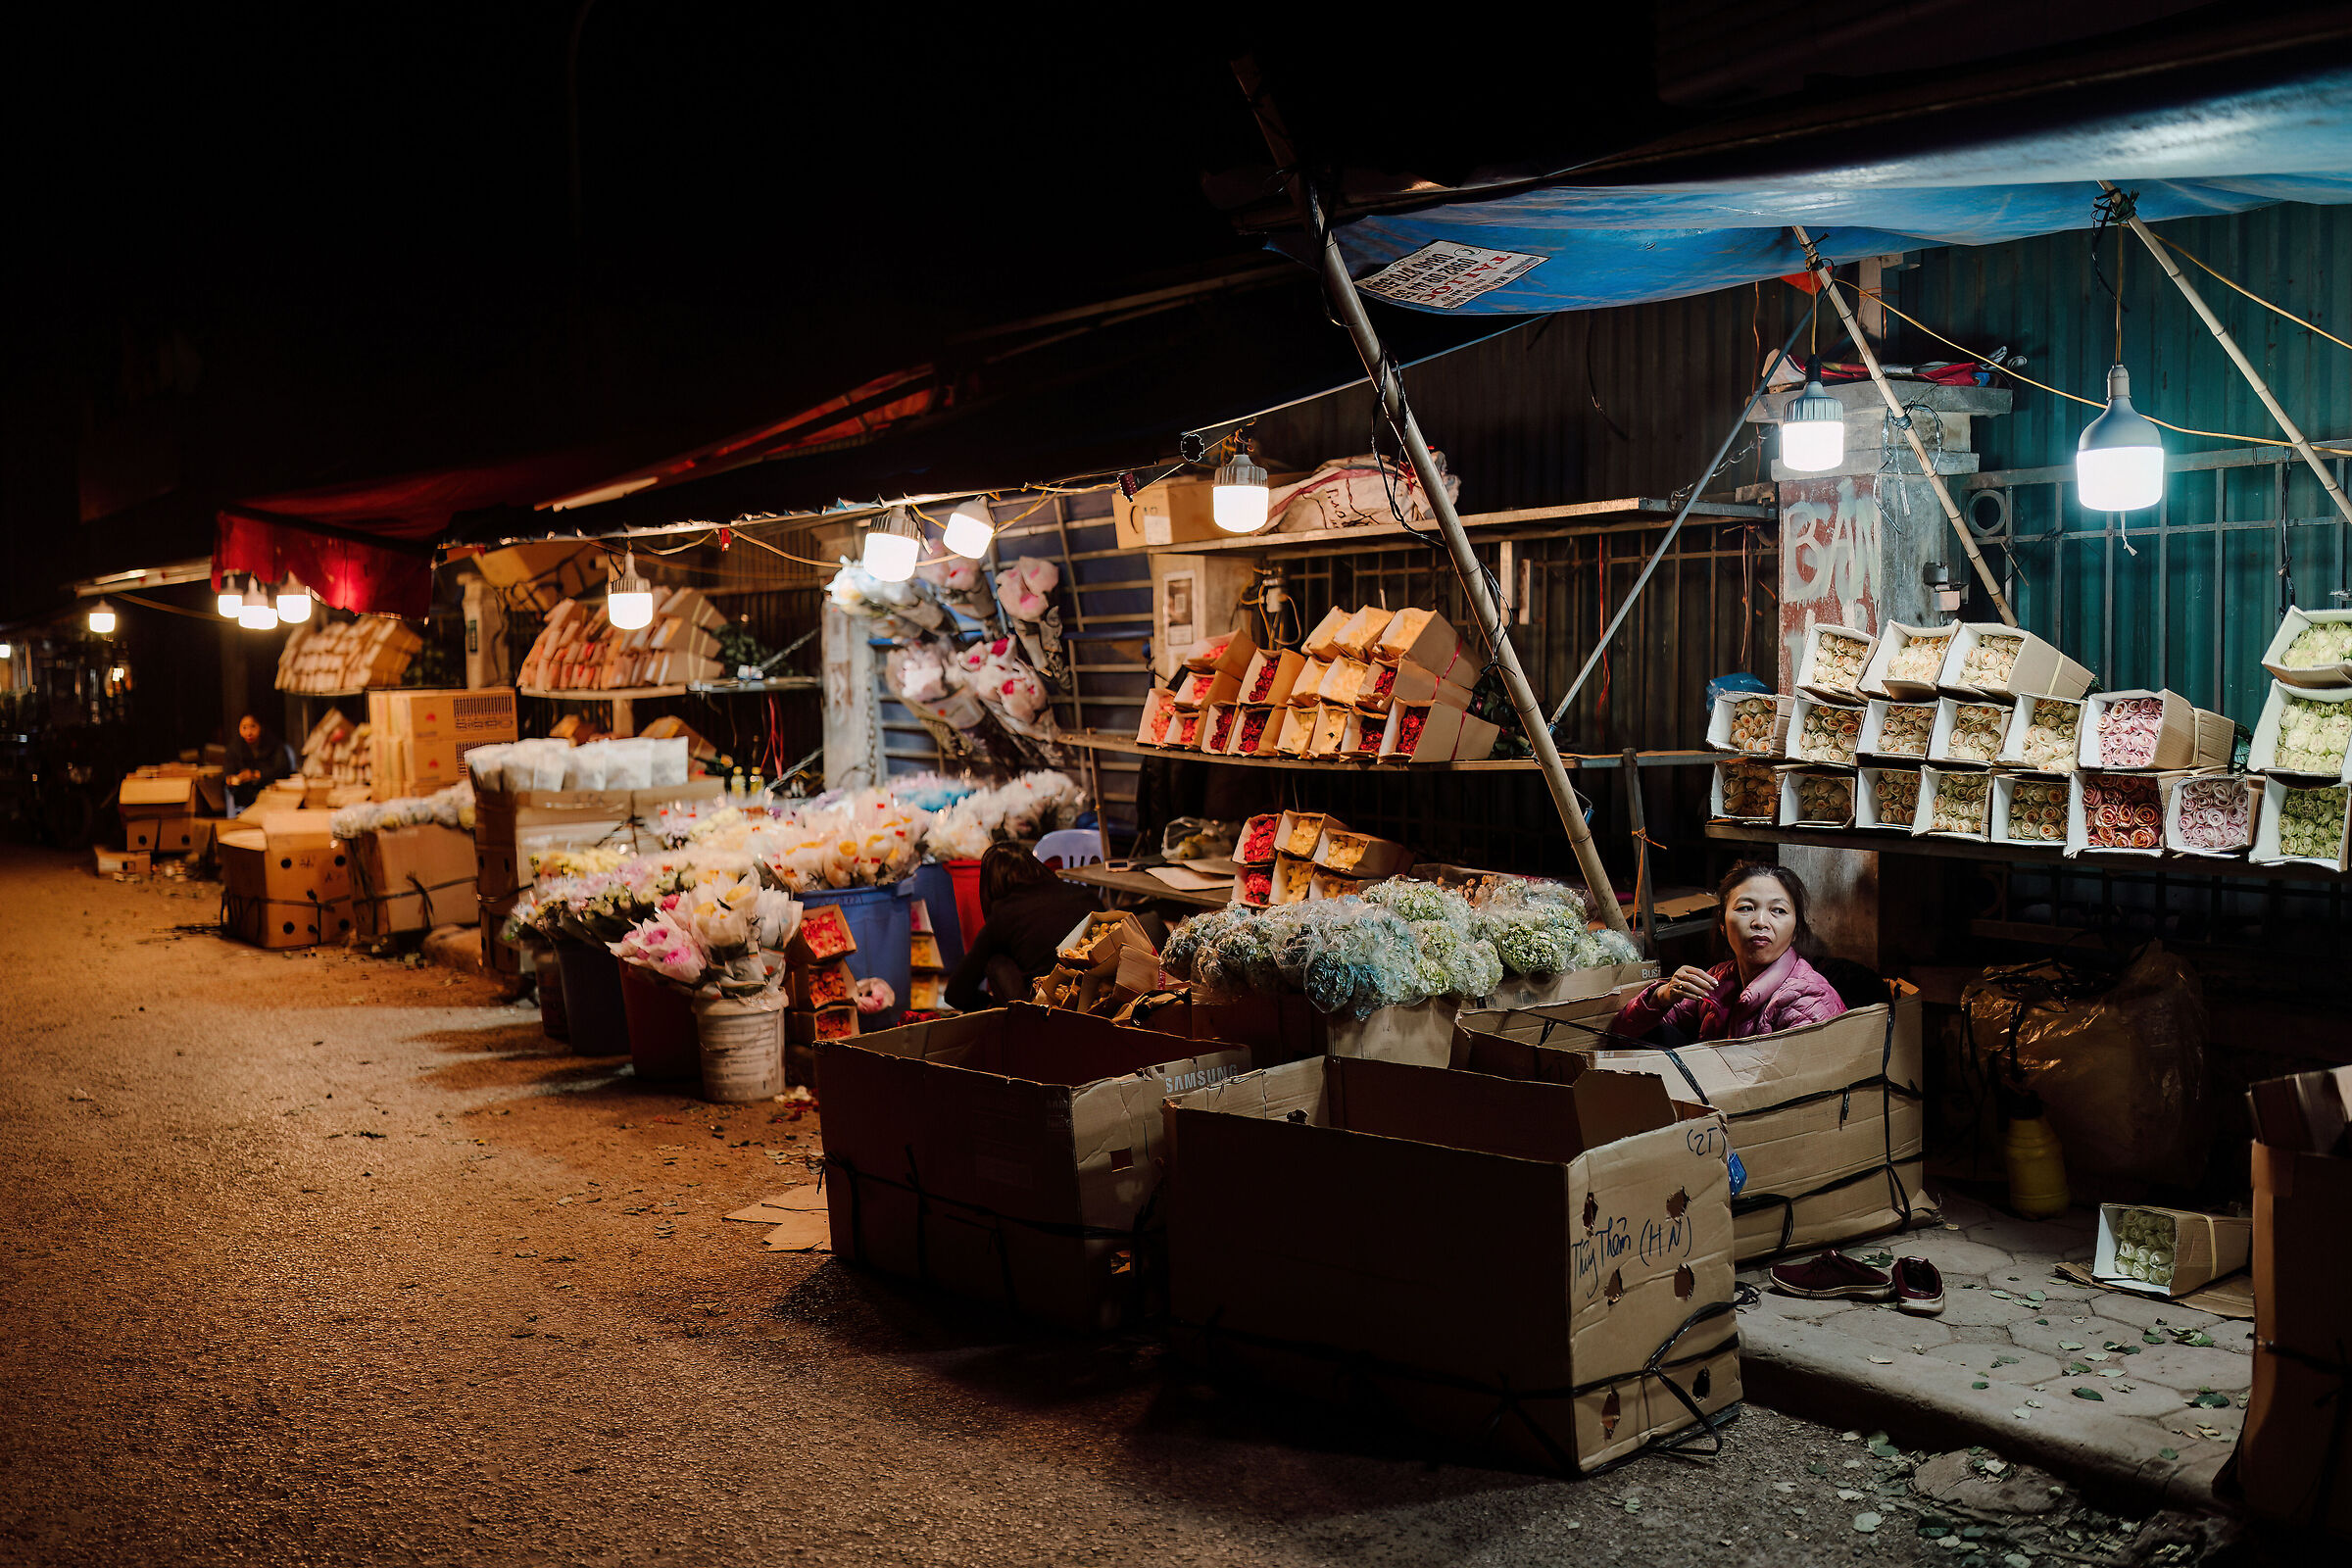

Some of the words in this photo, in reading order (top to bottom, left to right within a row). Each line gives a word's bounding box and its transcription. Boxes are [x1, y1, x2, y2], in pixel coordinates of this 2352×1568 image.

[1442, 258, 1480, 275] 0982
[1406, 280, 1429, 291] 44
[1165, 1063, 1239, 1094] SAMSUNG
